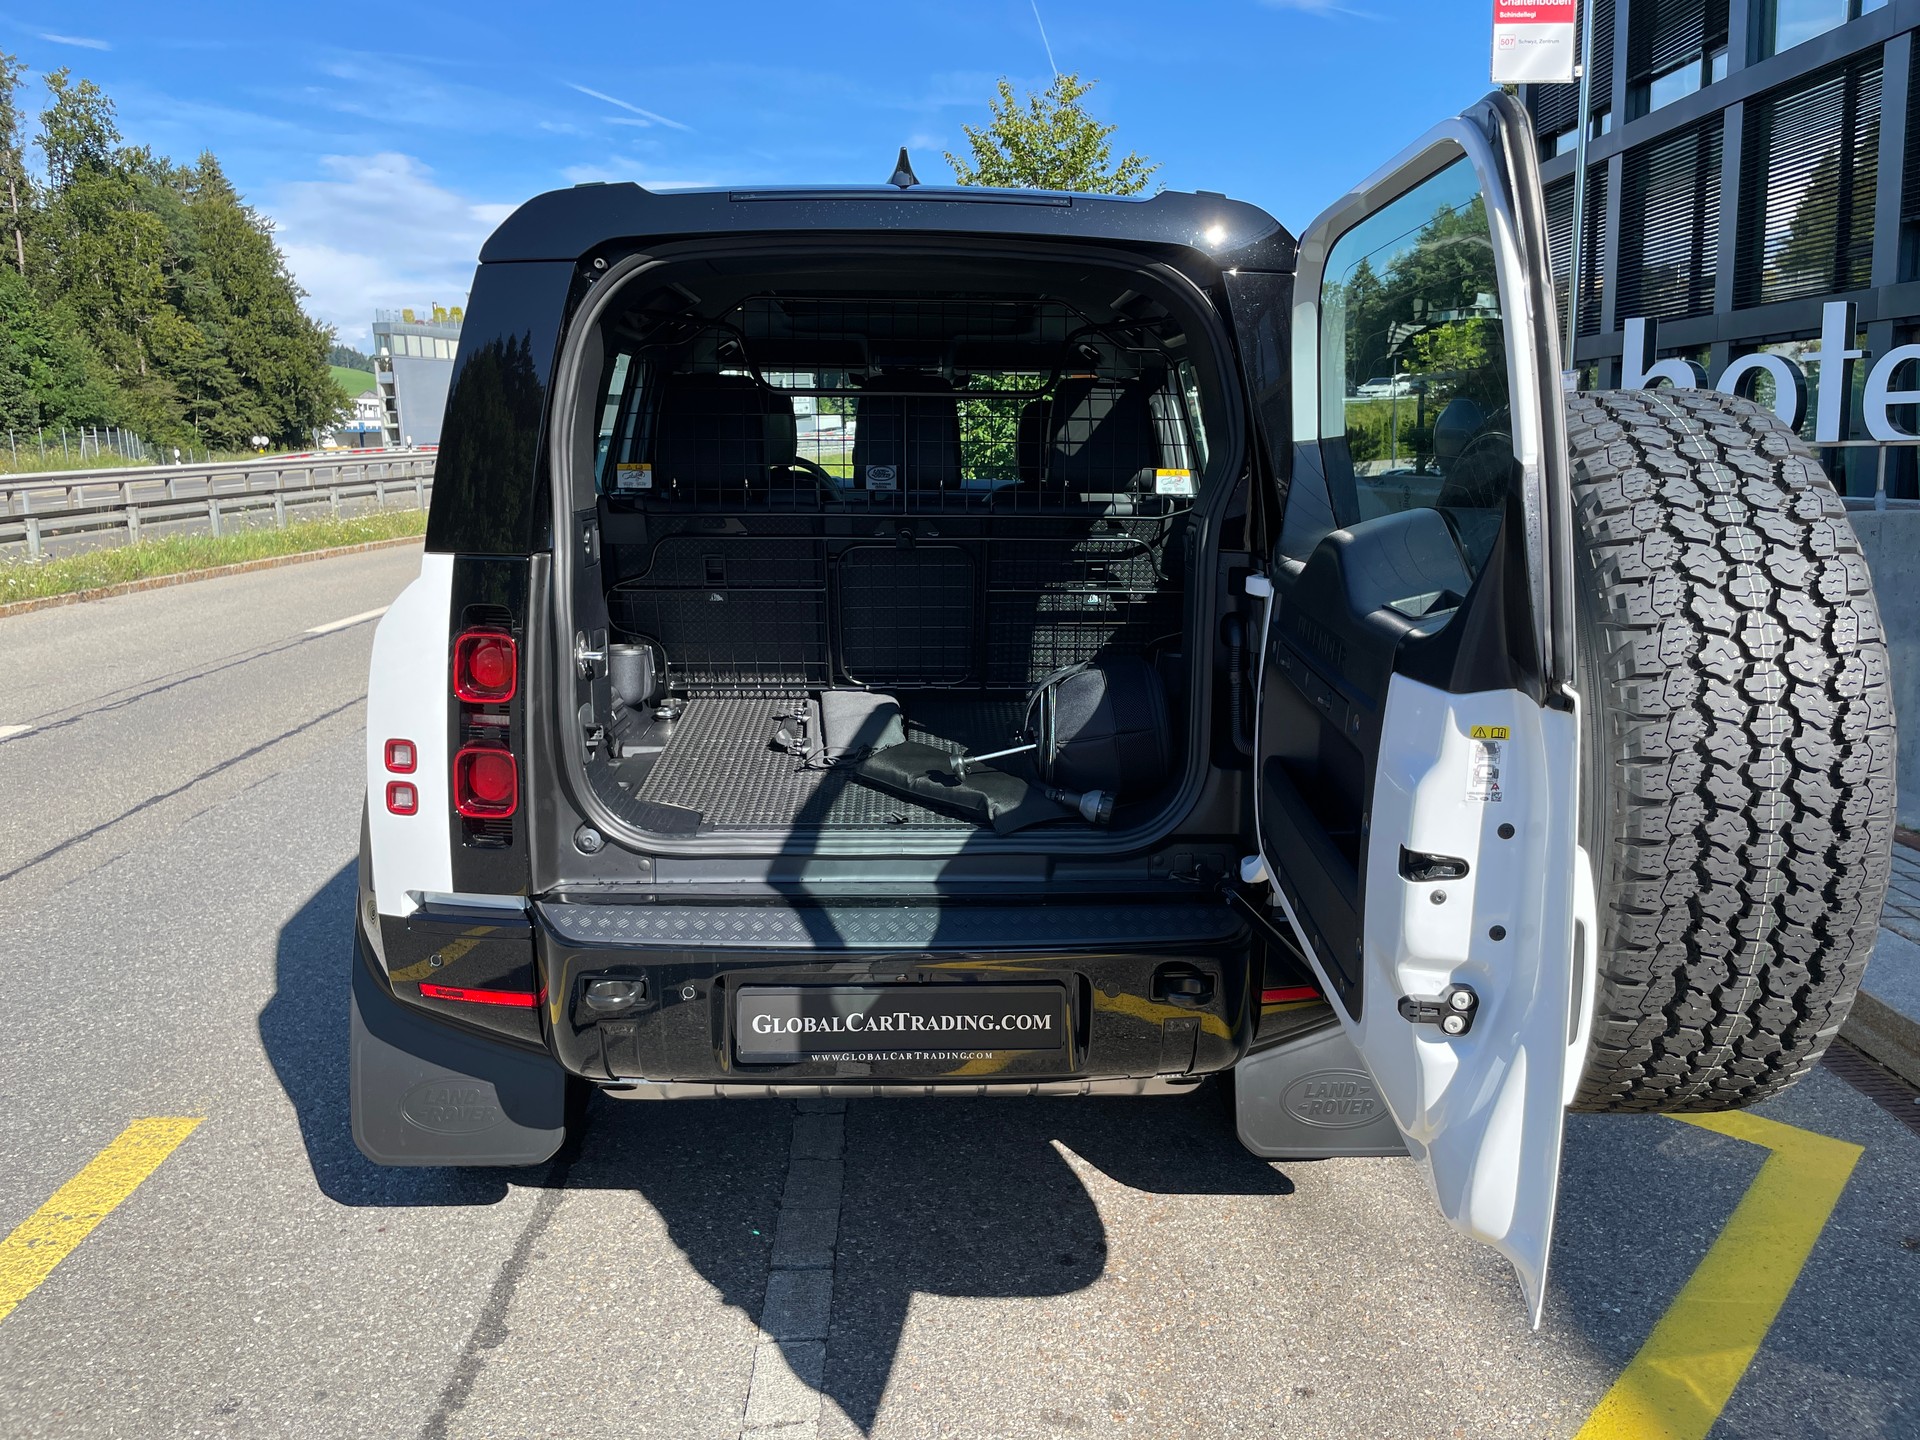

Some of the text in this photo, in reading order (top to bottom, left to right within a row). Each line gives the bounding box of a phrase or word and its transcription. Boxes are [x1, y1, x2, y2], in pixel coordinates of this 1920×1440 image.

[1499, 11, 1536, 19] Schindellegi
[1500, 38, 1514, 46] 507
[424, 1088, 481, 1106] LAND
[1303, 1081, 1357, 1099] LAND
[426, 1105, 498, 1122] ROVER
[1308, 1098, 1375, 1115] ROVER
